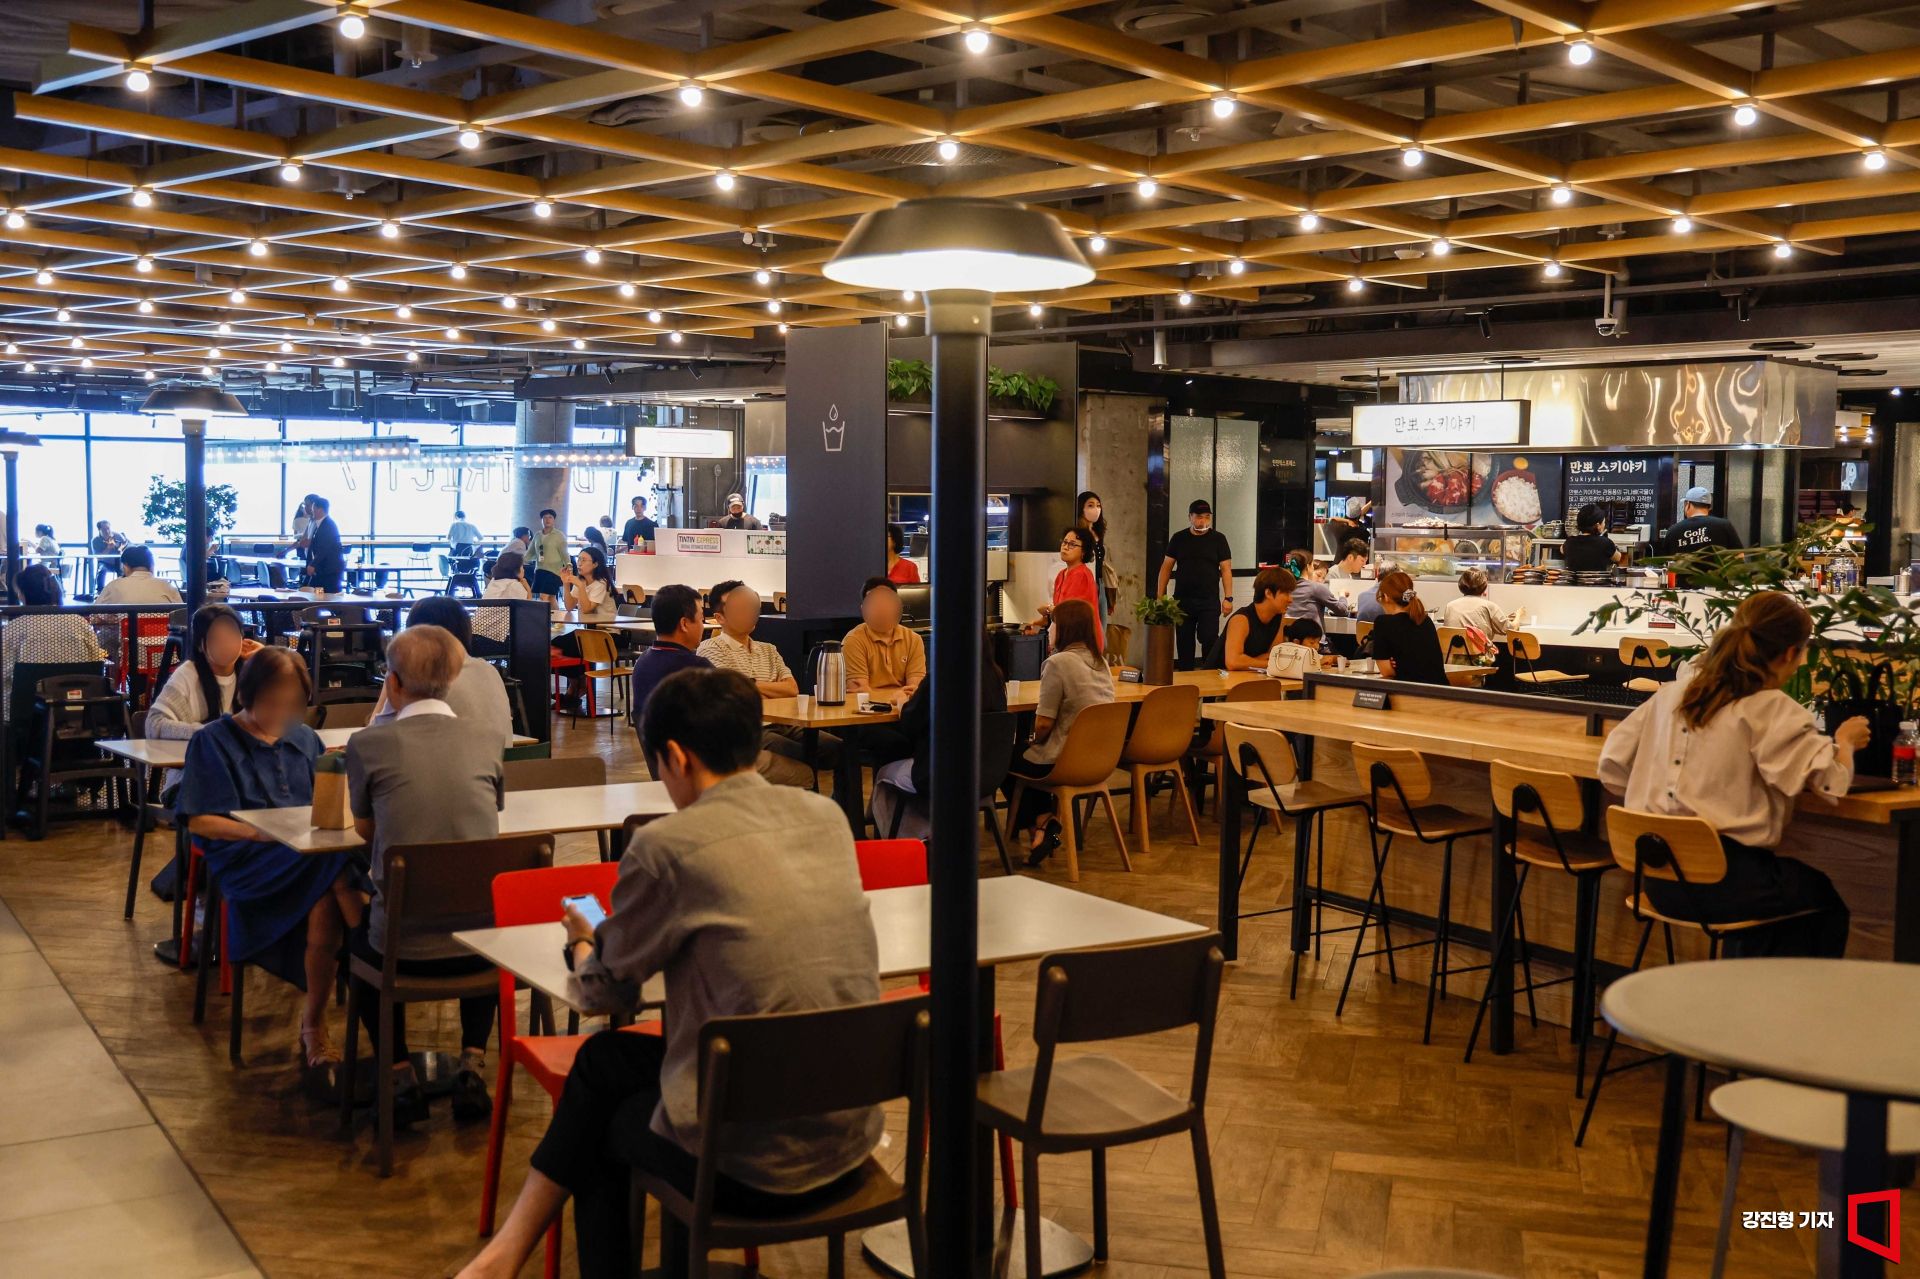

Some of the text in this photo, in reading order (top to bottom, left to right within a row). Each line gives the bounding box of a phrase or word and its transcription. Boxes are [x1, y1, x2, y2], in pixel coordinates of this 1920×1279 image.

[1394, 415, 1476, 433] 만뽀 스키야키
[1570, 460, 1647, 474] 만뽀 스키야키
[1683, 526, 1707, 538] Golf
[1678, 534, 1712, 547] Is Life.
